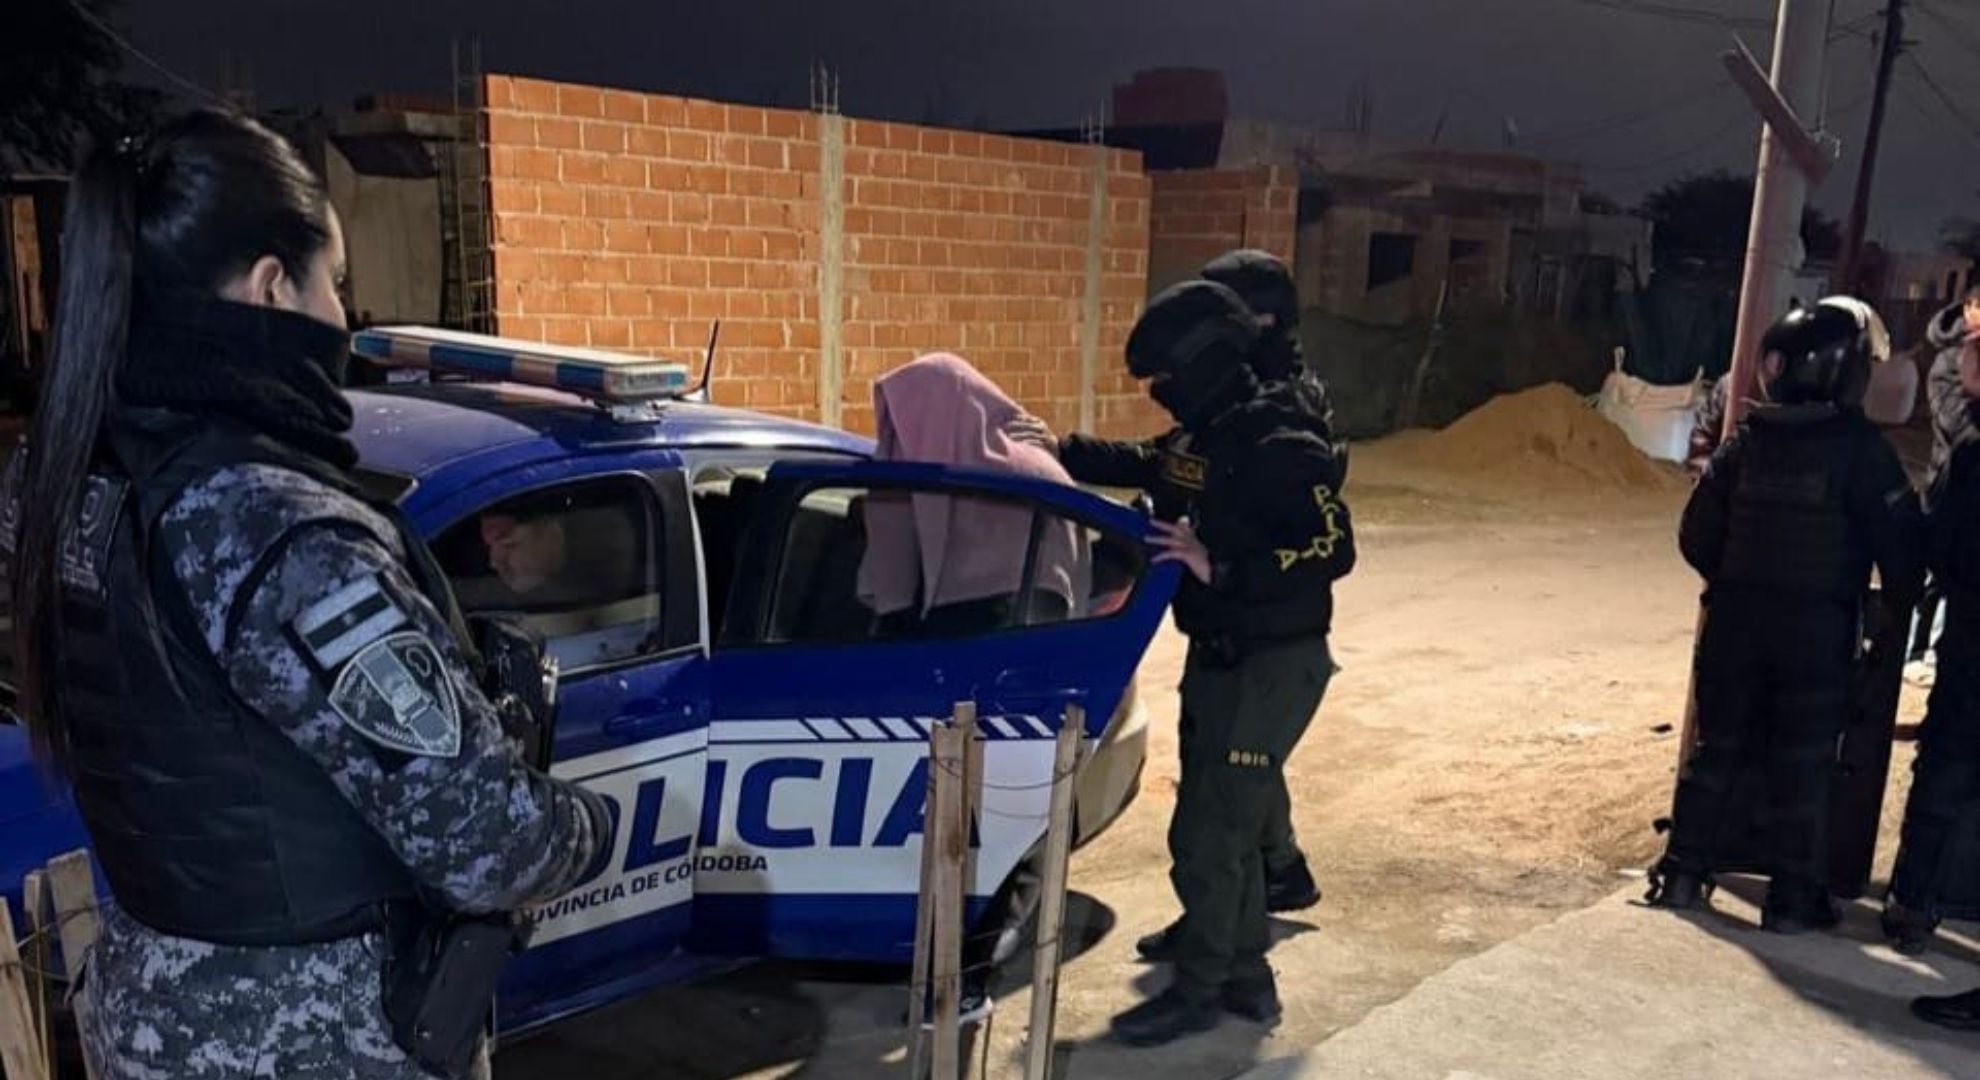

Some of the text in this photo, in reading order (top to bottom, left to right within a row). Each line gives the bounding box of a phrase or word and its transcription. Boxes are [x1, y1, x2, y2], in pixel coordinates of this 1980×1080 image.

[572, 757, 981, 888] LICIA
[534, 884, 625, 923] VINCIA
[631, 871, 660, 894] DE
